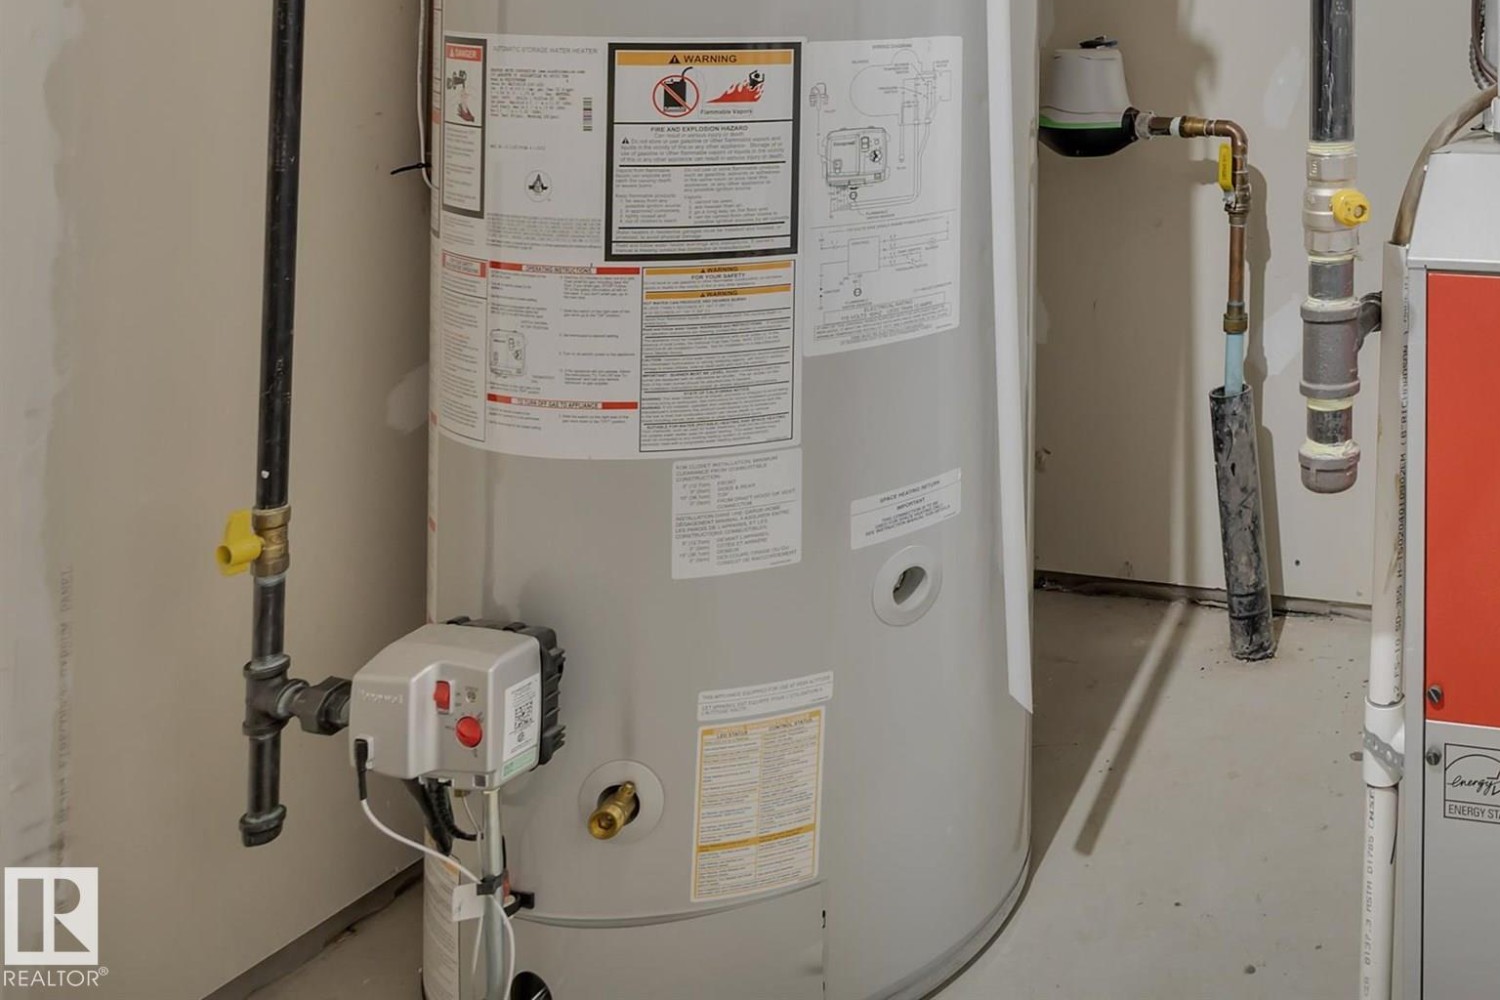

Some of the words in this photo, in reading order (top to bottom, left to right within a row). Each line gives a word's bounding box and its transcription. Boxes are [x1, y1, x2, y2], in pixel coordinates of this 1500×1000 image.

[573, 47, 598, 55] HEATER
[684, 54, 737, 63] WARNING
[732, 109, 753, 117] Vapors
[526, 265, 552, 273] OPERATING
[555, 266, 592, 274] INSTRUCTIONS
[568, 401, 598, 409] APPLIANCE
[880, 494, 897, 503] SPACE
[898, 486, 920, 497] HEATING
[921, 480, 940, 489] RETURN
[896, 497, 925, 510] IMPORTANT
[1447, 775, 1496, 796] energy
[1448, 803, 1485, 818] ENERGY
